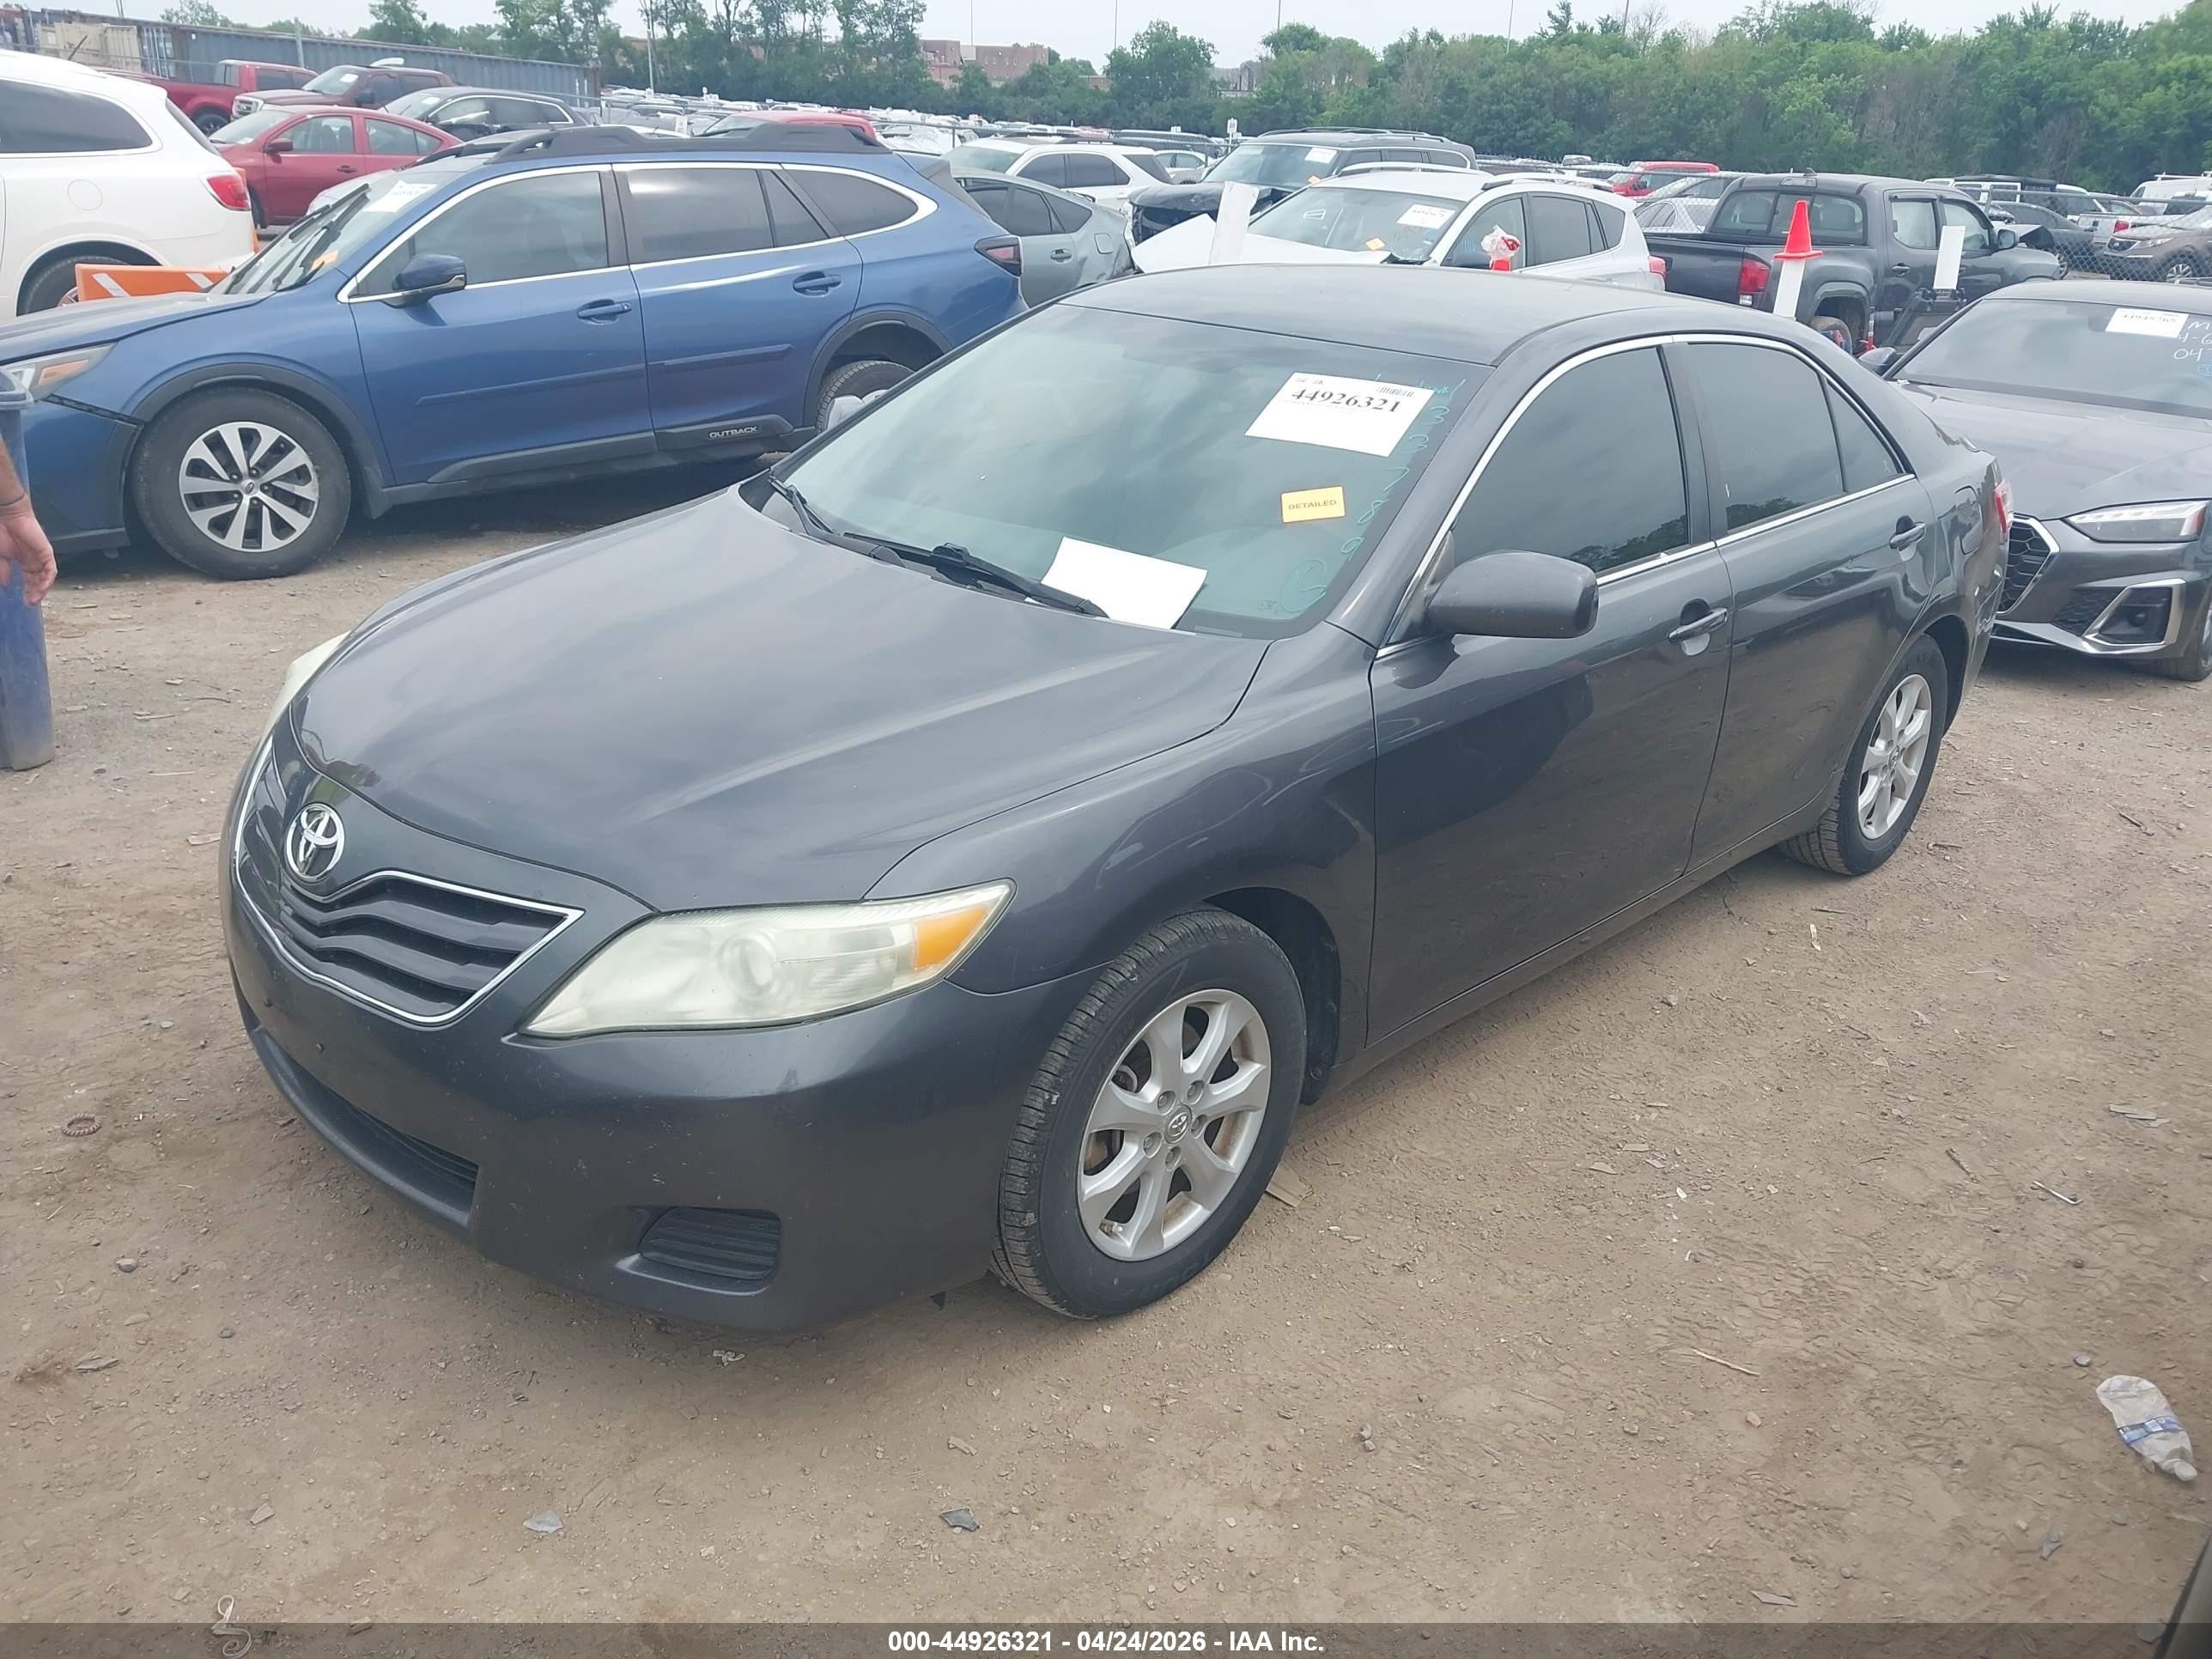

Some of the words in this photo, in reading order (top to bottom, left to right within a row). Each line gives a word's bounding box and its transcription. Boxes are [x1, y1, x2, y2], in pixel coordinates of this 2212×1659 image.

[1291, 388, 1402, 413] 44926321
[708, 426, 758, 438] OUTBACK
[1288, 499, 1337, 510] DETAILED
